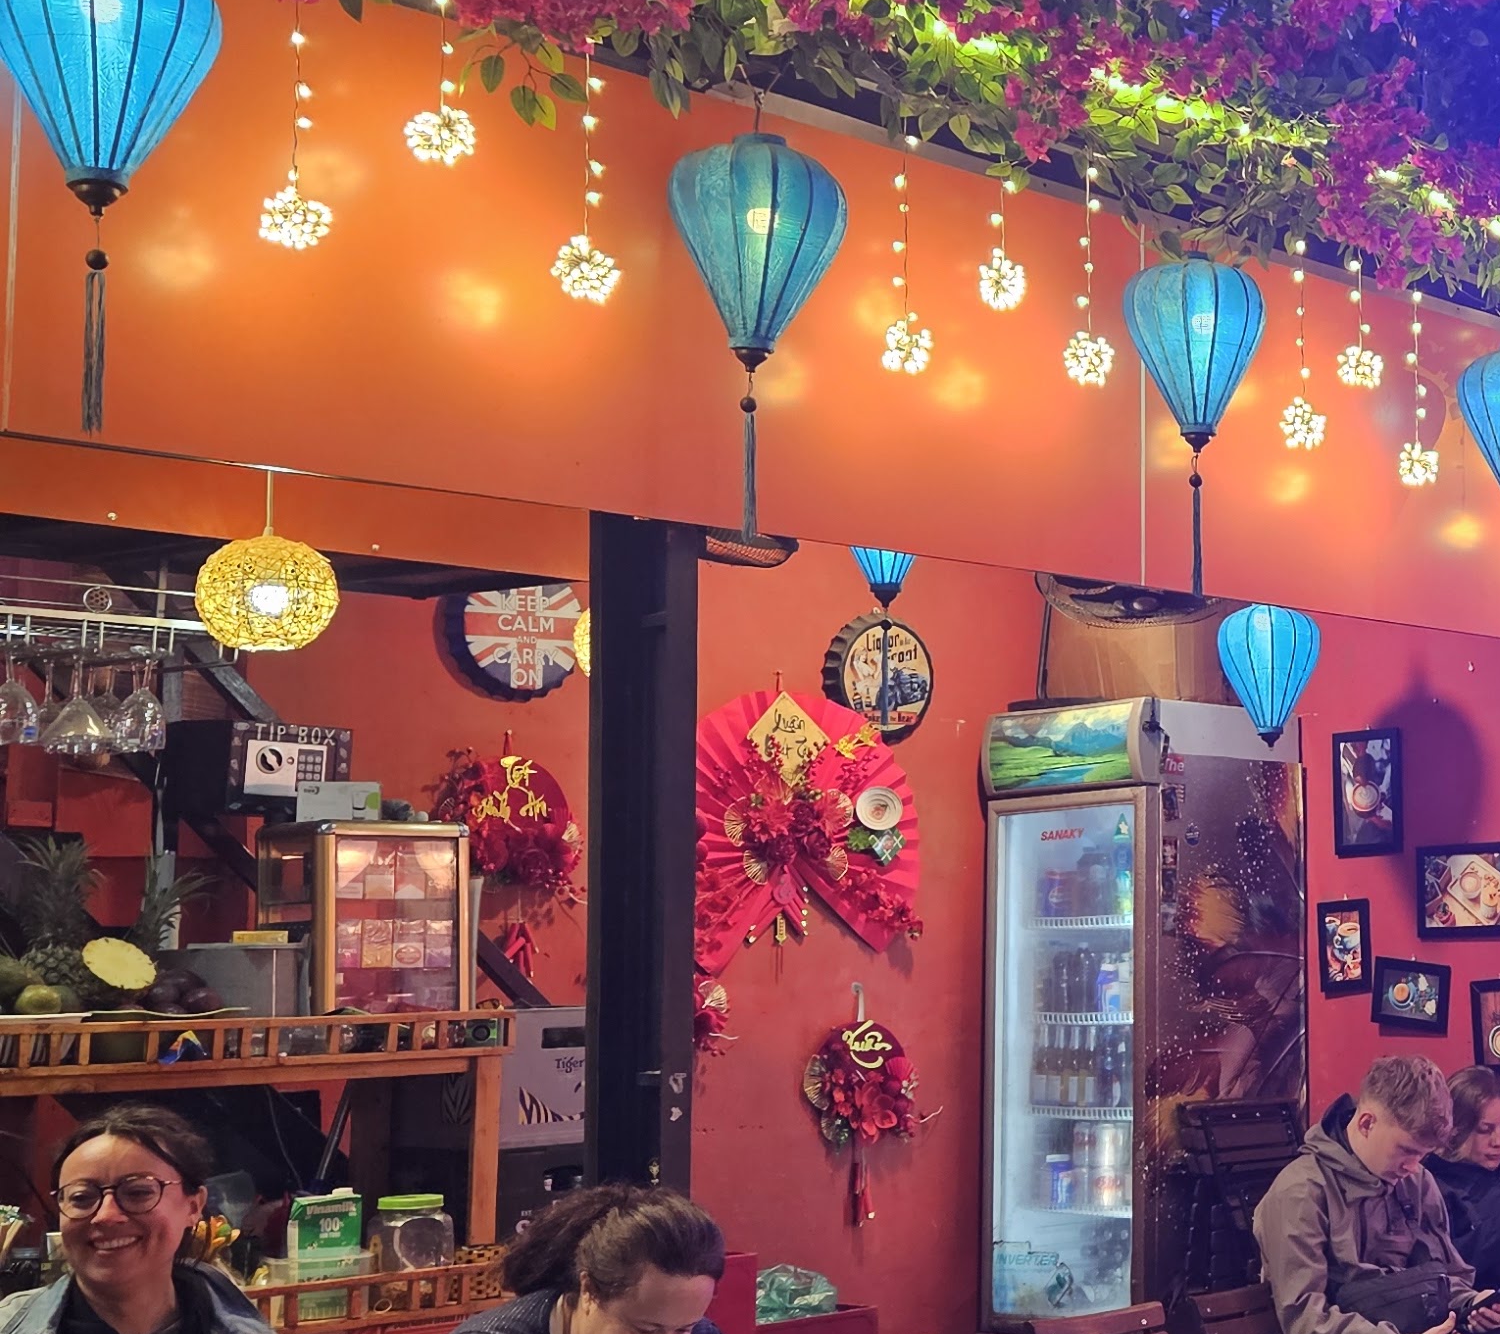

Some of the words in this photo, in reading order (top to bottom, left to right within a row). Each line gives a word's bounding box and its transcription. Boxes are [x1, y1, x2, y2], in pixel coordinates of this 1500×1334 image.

[501, 593, 550, 613] KEEP
[497, 614, 555, 634] CALM
[516, 635, 538, 644] AND
[492, 648, 557, 666] CARRY
[512, 668, 542, 686] ON
[254, 723, 286, 742] TIP
[298, 726, 336, 746] BOX
[1040, 828, 1084, 841] SANAKY
[555, 1056, 585, 1074] Tiger
[306, 1201, 357, 1216] Vinamilk
